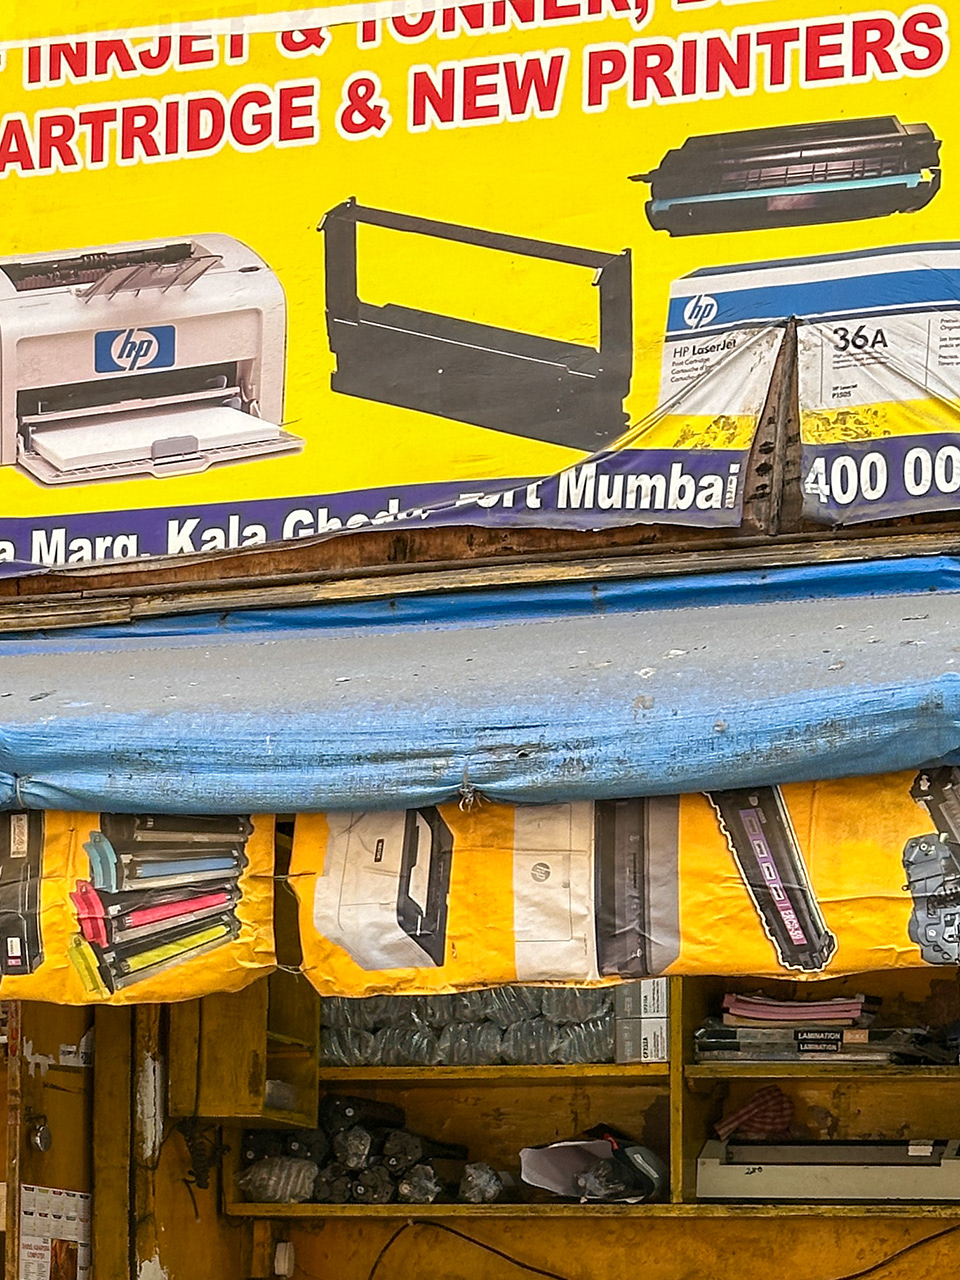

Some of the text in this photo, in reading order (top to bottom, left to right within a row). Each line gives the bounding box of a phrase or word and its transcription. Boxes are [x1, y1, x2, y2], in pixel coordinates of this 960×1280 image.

[340, 78, 385, 134] &
[413, 55, 564, 126] NEW
[587, 12, 943, 106] PRINTERS
[688, 294, 715, 329] hp
[116, 328, 154, 371] hp
[673, 339, 737, 358] HP LaserJet
[833, 325, 888, 352] 36A
[167, 514, 267, 555] Kala
[557, 463, 741, 510] Mumbai
[804, 452, 888, 504] 400
[798, 1032, 841, 1040] LAMINATION
[800, 1043, 838, 1051] LAMINATION
